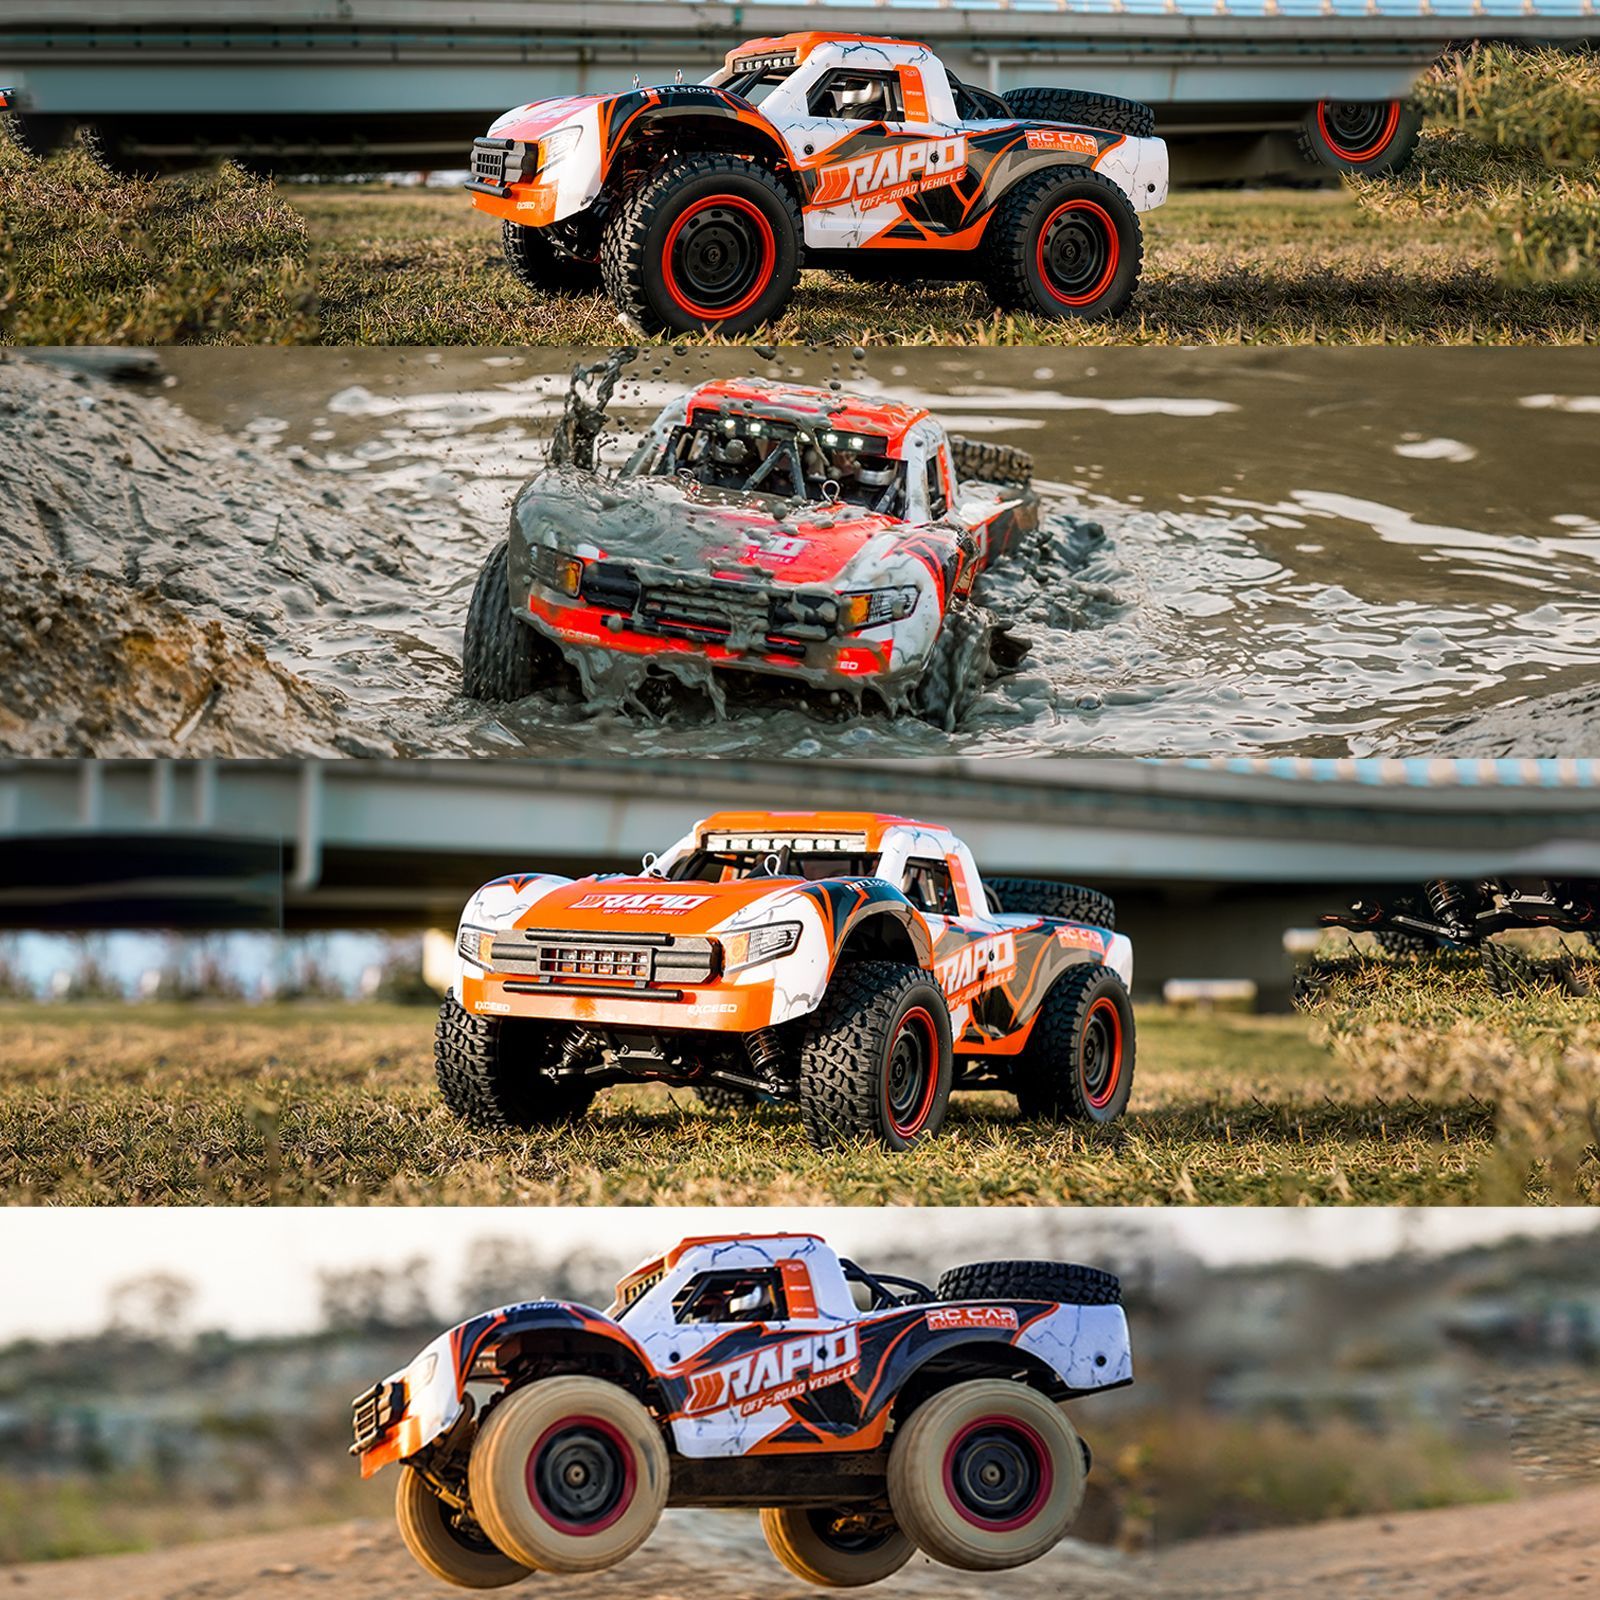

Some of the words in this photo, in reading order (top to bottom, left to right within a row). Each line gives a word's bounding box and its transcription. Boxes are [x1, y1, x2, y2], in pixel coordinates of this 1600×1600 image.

[1027, 132, 1055, 142] RC
[1059, 133, 1096, 147] CAR
[840, 136, 966, 197] RAPID
[862, 183, 918, 209] OFF-ROAD
[920, 170, 968, 192] VEHICLE
[603, 894, 713, 909] RAPID
[936, 931, 1014, 996] RAPID
[931, 1310, 962, 1322] RC
[966, 1307, 1014, 1321] CAR
[718, 1325, 857, 1400] RAPID
[743, 1384, 806, 1416] OFF-ROAD
[808, 1361, 861, 1392] VEHICLE
